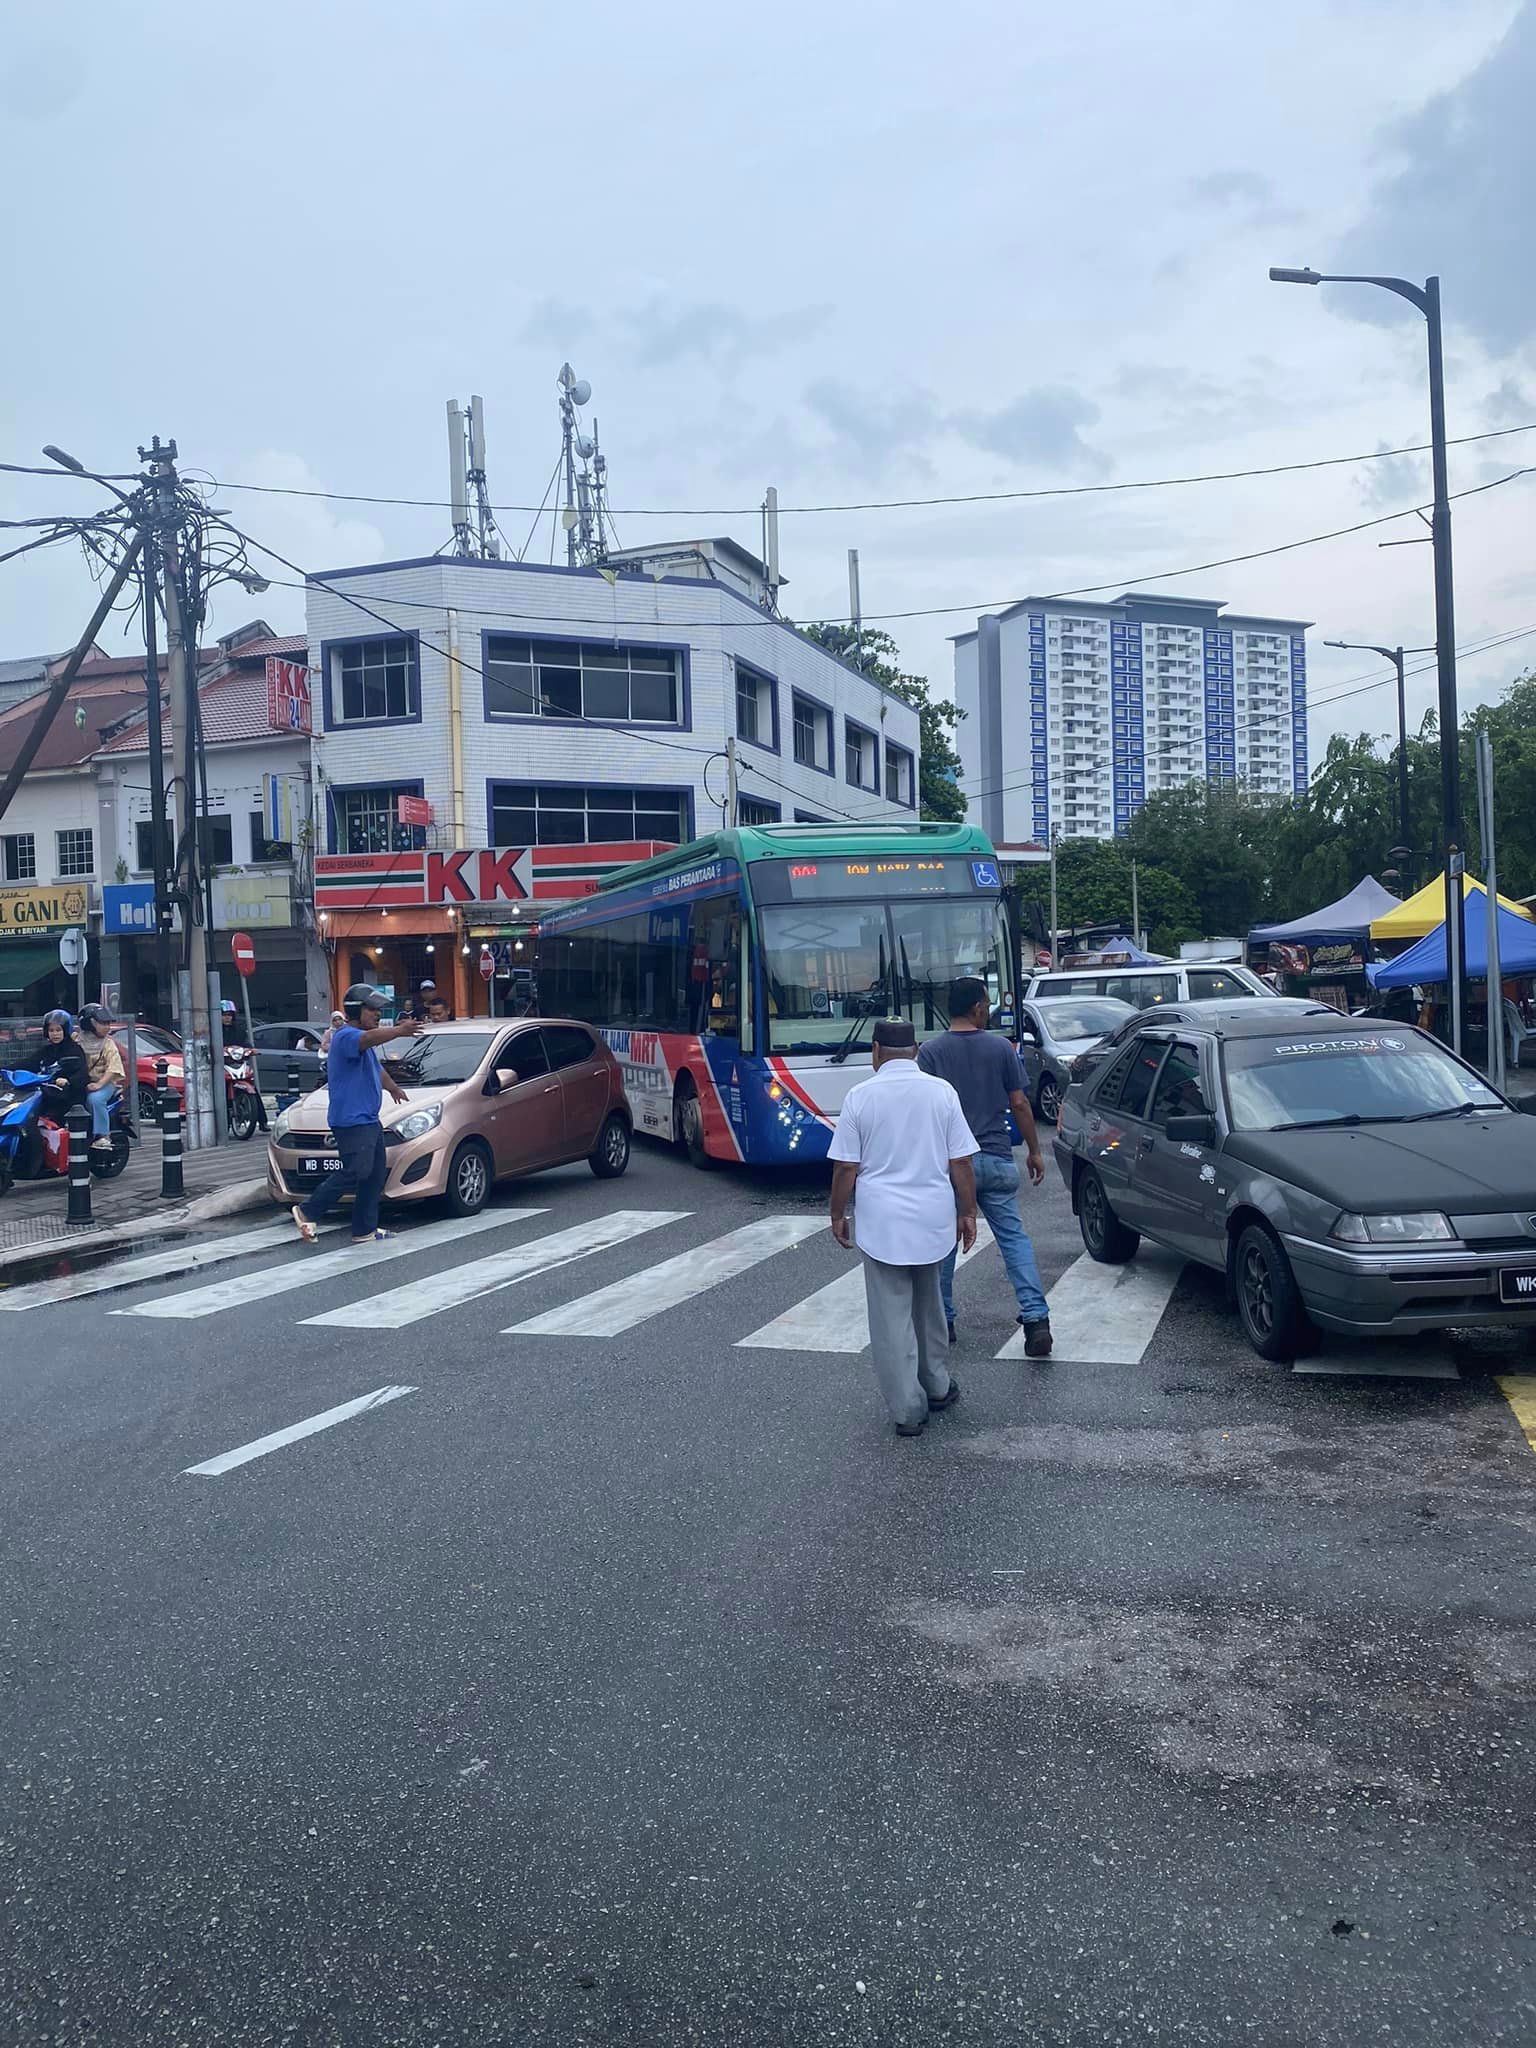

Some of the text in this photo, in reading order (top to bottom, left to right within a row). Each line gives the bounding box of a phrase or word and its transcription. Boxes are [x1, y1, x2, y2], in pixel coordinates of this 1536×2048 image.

[278, 661, 309, 701] KK
[290, 698, 300, 729] 24
[428, 848, 529, 902] KK
[668, 876, 680, 892] BAS
[13, 900, 59, 923] GANI
[22, 926, 48, 935] BRIYANI
[631, 1032, 658, 1065] MRT
[1275, 1039, 1378, 1054] PROTON
